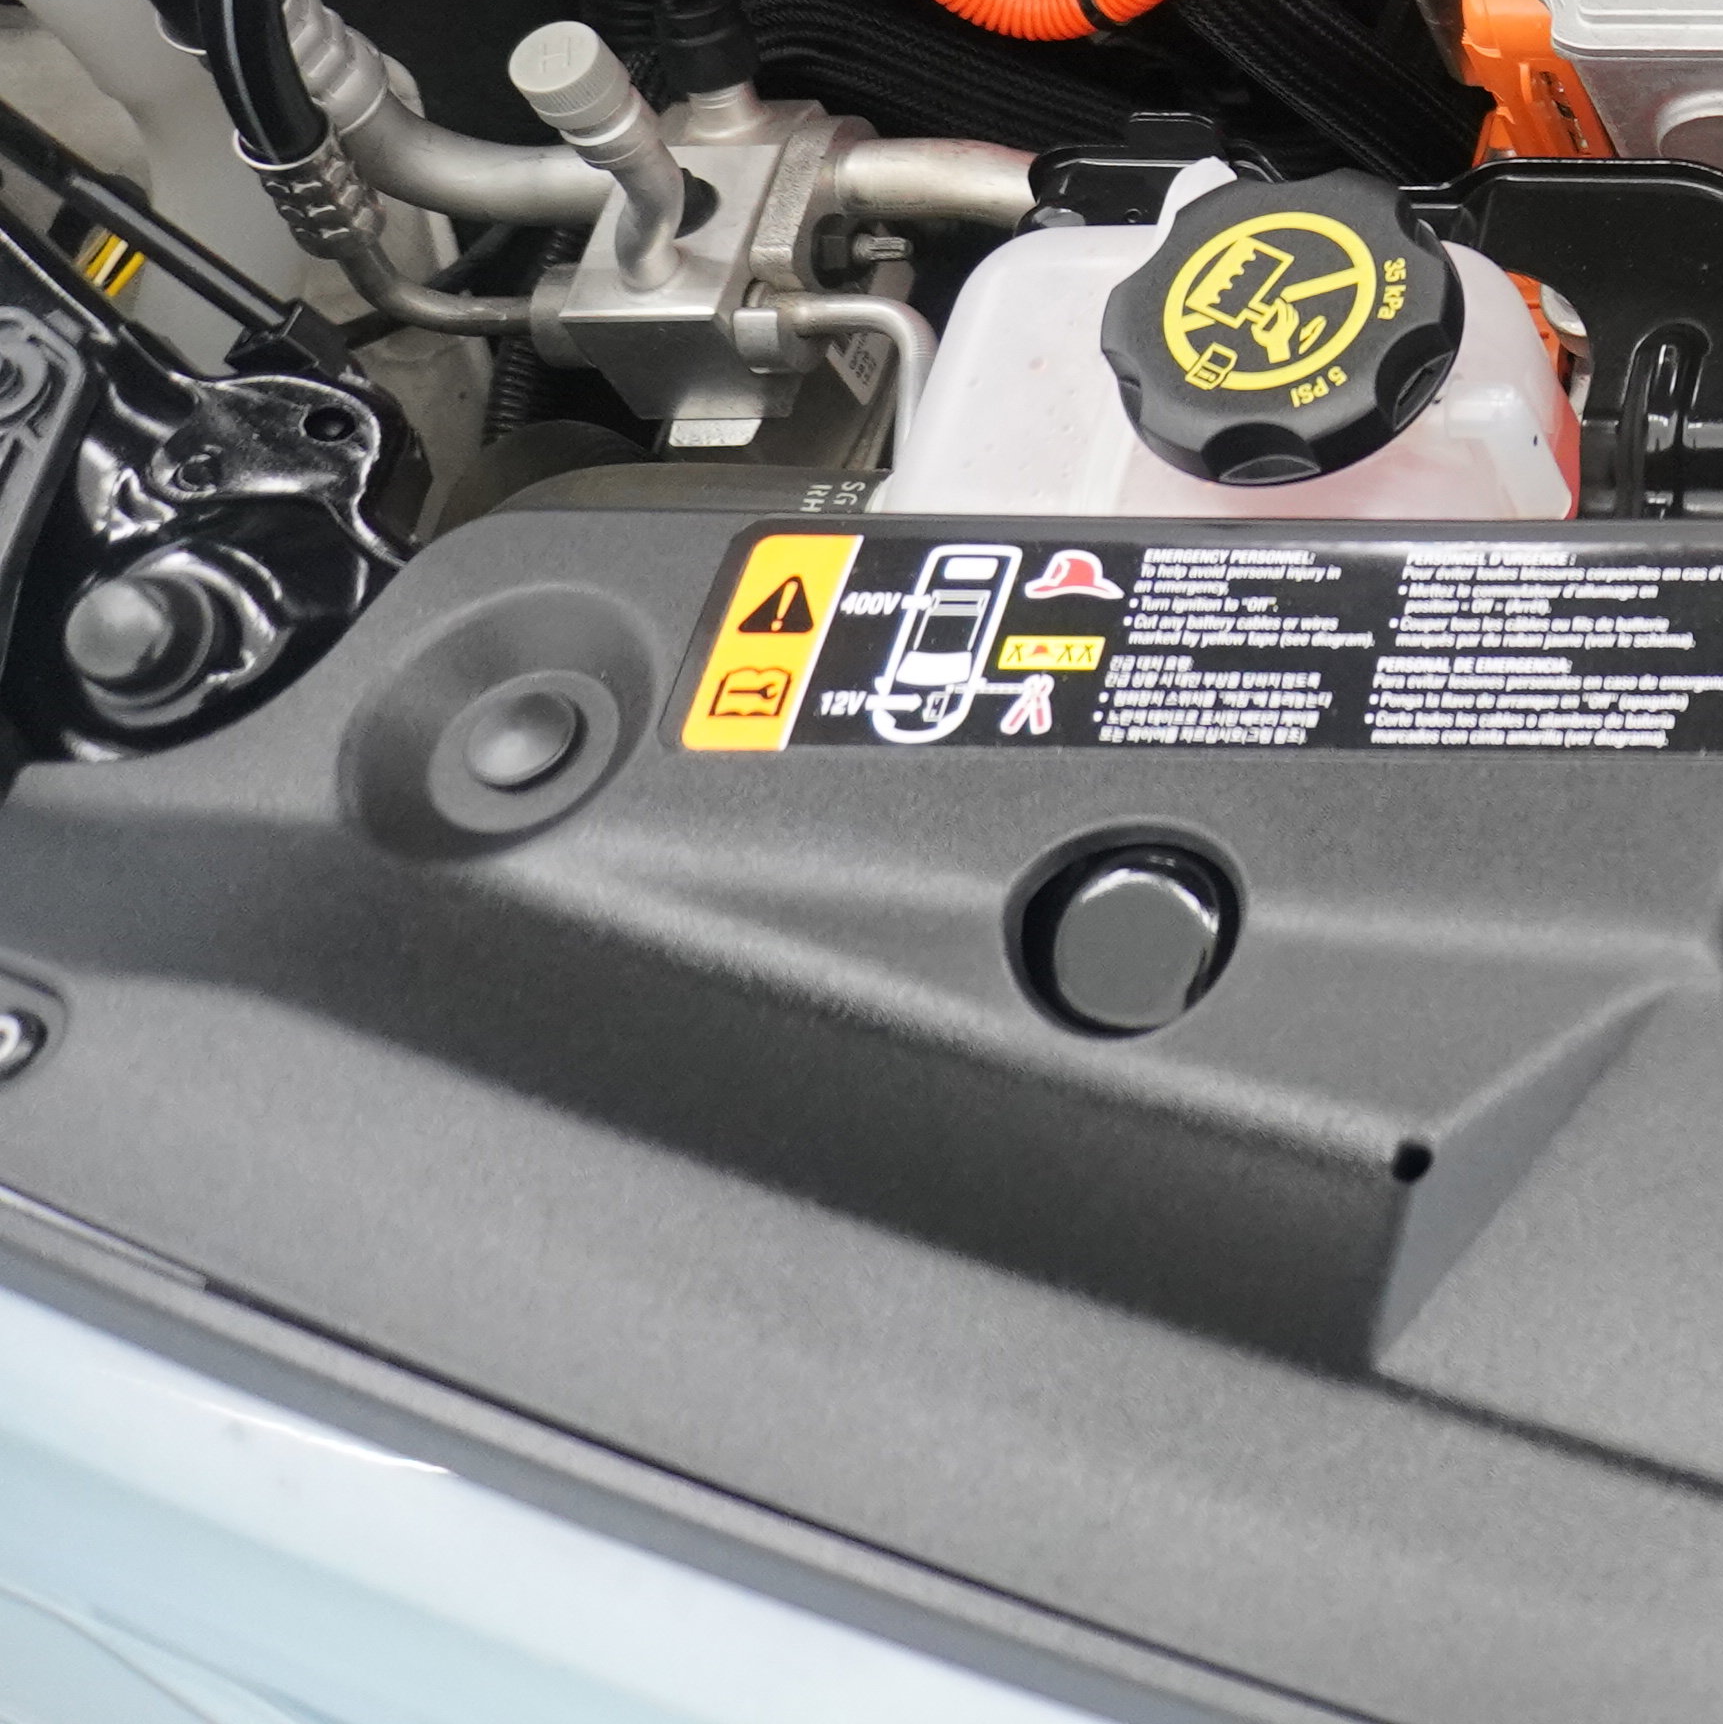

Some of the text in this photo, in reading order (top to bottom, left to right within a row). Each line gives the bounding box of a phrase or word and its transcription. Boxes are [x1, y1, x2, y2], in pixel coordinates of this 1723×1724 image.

[1377, 256, 1407, 321] 35 kPa
[1289, 365, 1349, 408] 5 PSI
[799, 482, 832, 513] RH
[833, 480, 867, 506] SG
[1143, 549, 1229, 564] EMERGENCY
[1141, 564, 1342, 582] To help avoid personal injury in
[1134, 581, 1152, 593] an
[841, 592, 900, 615] 400V
[1142, 596, 1170, 611] Turn
[1172, 596, 1222, 613] ignition
[1224, 597, 1240, 612] to
[1134, 614, 1338, 632] Cut any battery cables or wires
[1129, 631, 1181, 646] marked
[1182, 631, 1200, 647] by
[1201, 631, 1246, 648] yellow
[1248, 632, 1279, 648] tape
[820, 692, 865, 716] 12V
